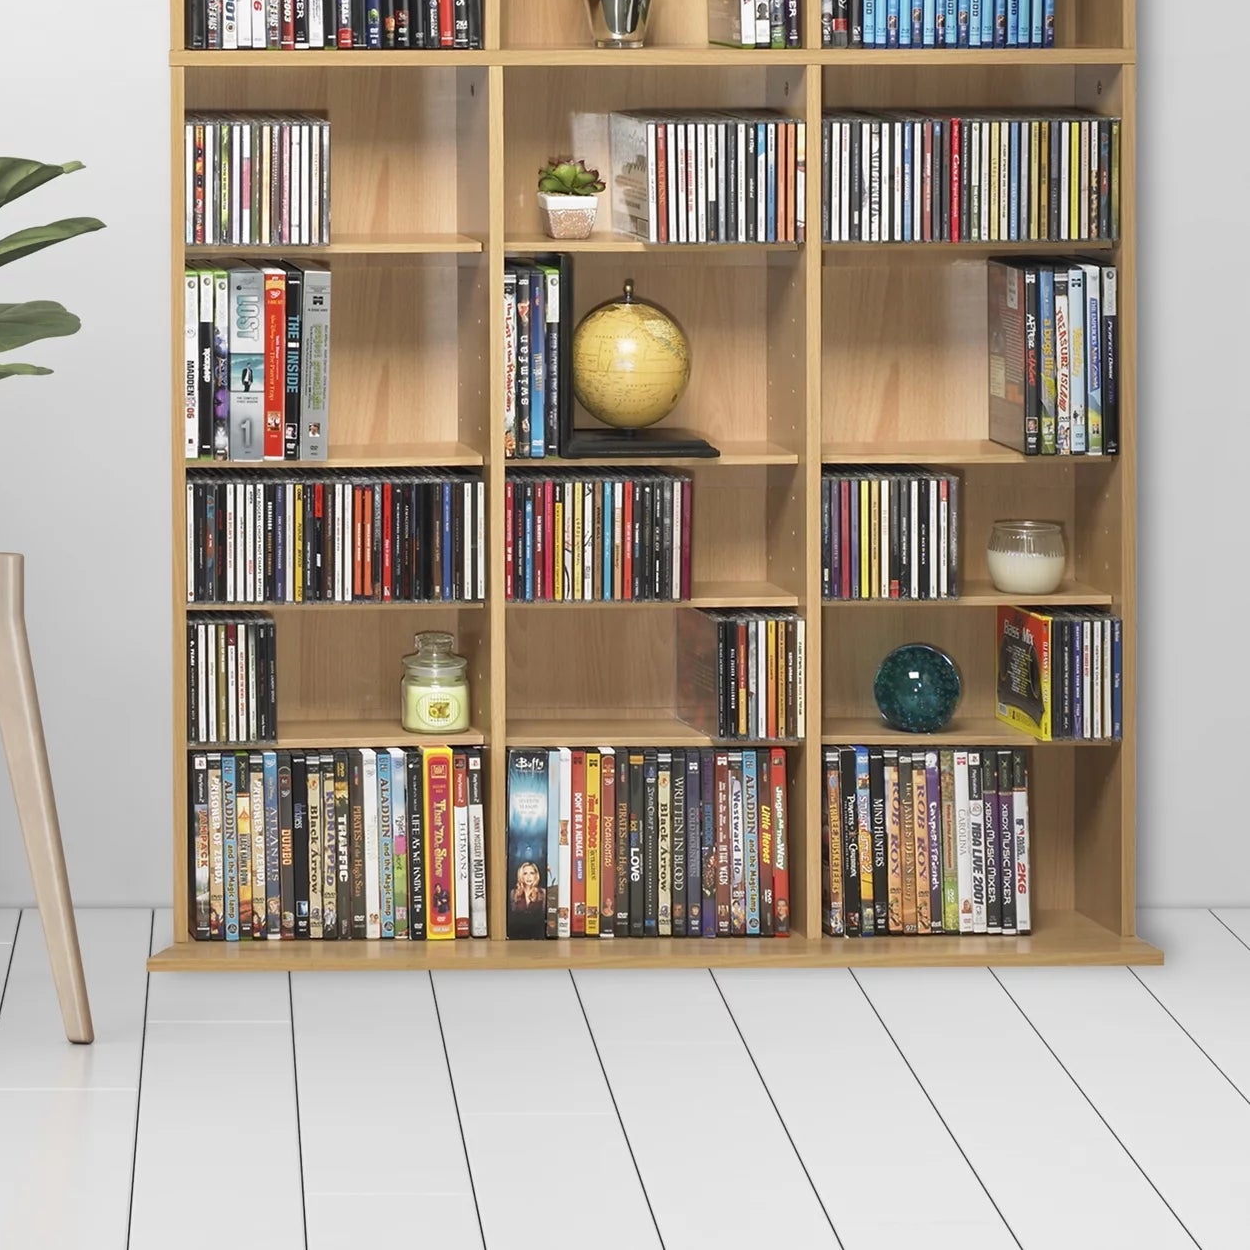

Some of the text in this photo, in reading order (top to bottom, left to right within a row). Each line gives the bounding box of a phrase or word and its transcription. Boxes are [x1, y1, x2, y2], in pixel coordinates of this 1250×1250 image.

[237, 295, 261, 343] LOST
[506, 317, 514, 338] Last
[1043, 328, 1053, 355] bug's
[287, 316, 299, 392] THE INSIDE
[518, 335, 529, 405] swimfan
[1045, 357, 1053, 377] life
[1056, 306, 1069, 411] TREASURE ISLAND
[187, 407, 194, 419] 06
[506, 365, 515, 411] Mohicans
[515, 757, 544, 770] Buffy
[211, 777, 223, 884] PRISONER OF ZENDA
[252, 779, 265, 887] PRISONER OF ZENDA
[411, 814, 420, 835] LIFE
[674, 776, 685, 891] WRITTEN IN BLOOD
[733, 790, 742, 875] Westward Ho
[745, 775, 756, 835] ALADDIN
[873, 799, 885, 868] MIND HUNTERS
[891, 782, 900, 878] ROB ROY
[917, 784, 927, 881] ROB ROY
[958, 809, 968, 856] CAROLINA
[200, 810, 209, 868] JAMPACK
[270, 807, 279, 882] ATLANTIS
[281, 829, 292, 866] DUMBO
[310, 805, 320, 895] Black Arrow
[326, 791, 336, 887] KIDNAPPED
[338, 814, 349, 883] TRAFFIC
[412, 837, 420, 849] AS
[413, 852, 420, 864] WE
[660, 803, 669, 892] Black Arrow
[689, 807, 697, 878] COLD MOUNTAIN
[762, 805, 771, 864] Little Heroes
[859, 795, 873, 874] STUART LITTLE 2
[928, 801, 940, 891] Casper Friends
[986, 830, 996, 866] MUSIC
[1002, 831, 1012, 868] MUSIC
[413, 867, 421, 892] KNOW
[459, 872, 467, 881] 2
[749, 870, 758, 892] Magic
[972, 822, 984, 906] NBA LIVE 2001
[988, 867, 997, 903] MIXER
[1003, 869, 1013, 905] MIXER
[1018, 862, 1027, 894] 2K6
[750, 894, 759, 913] lamp
